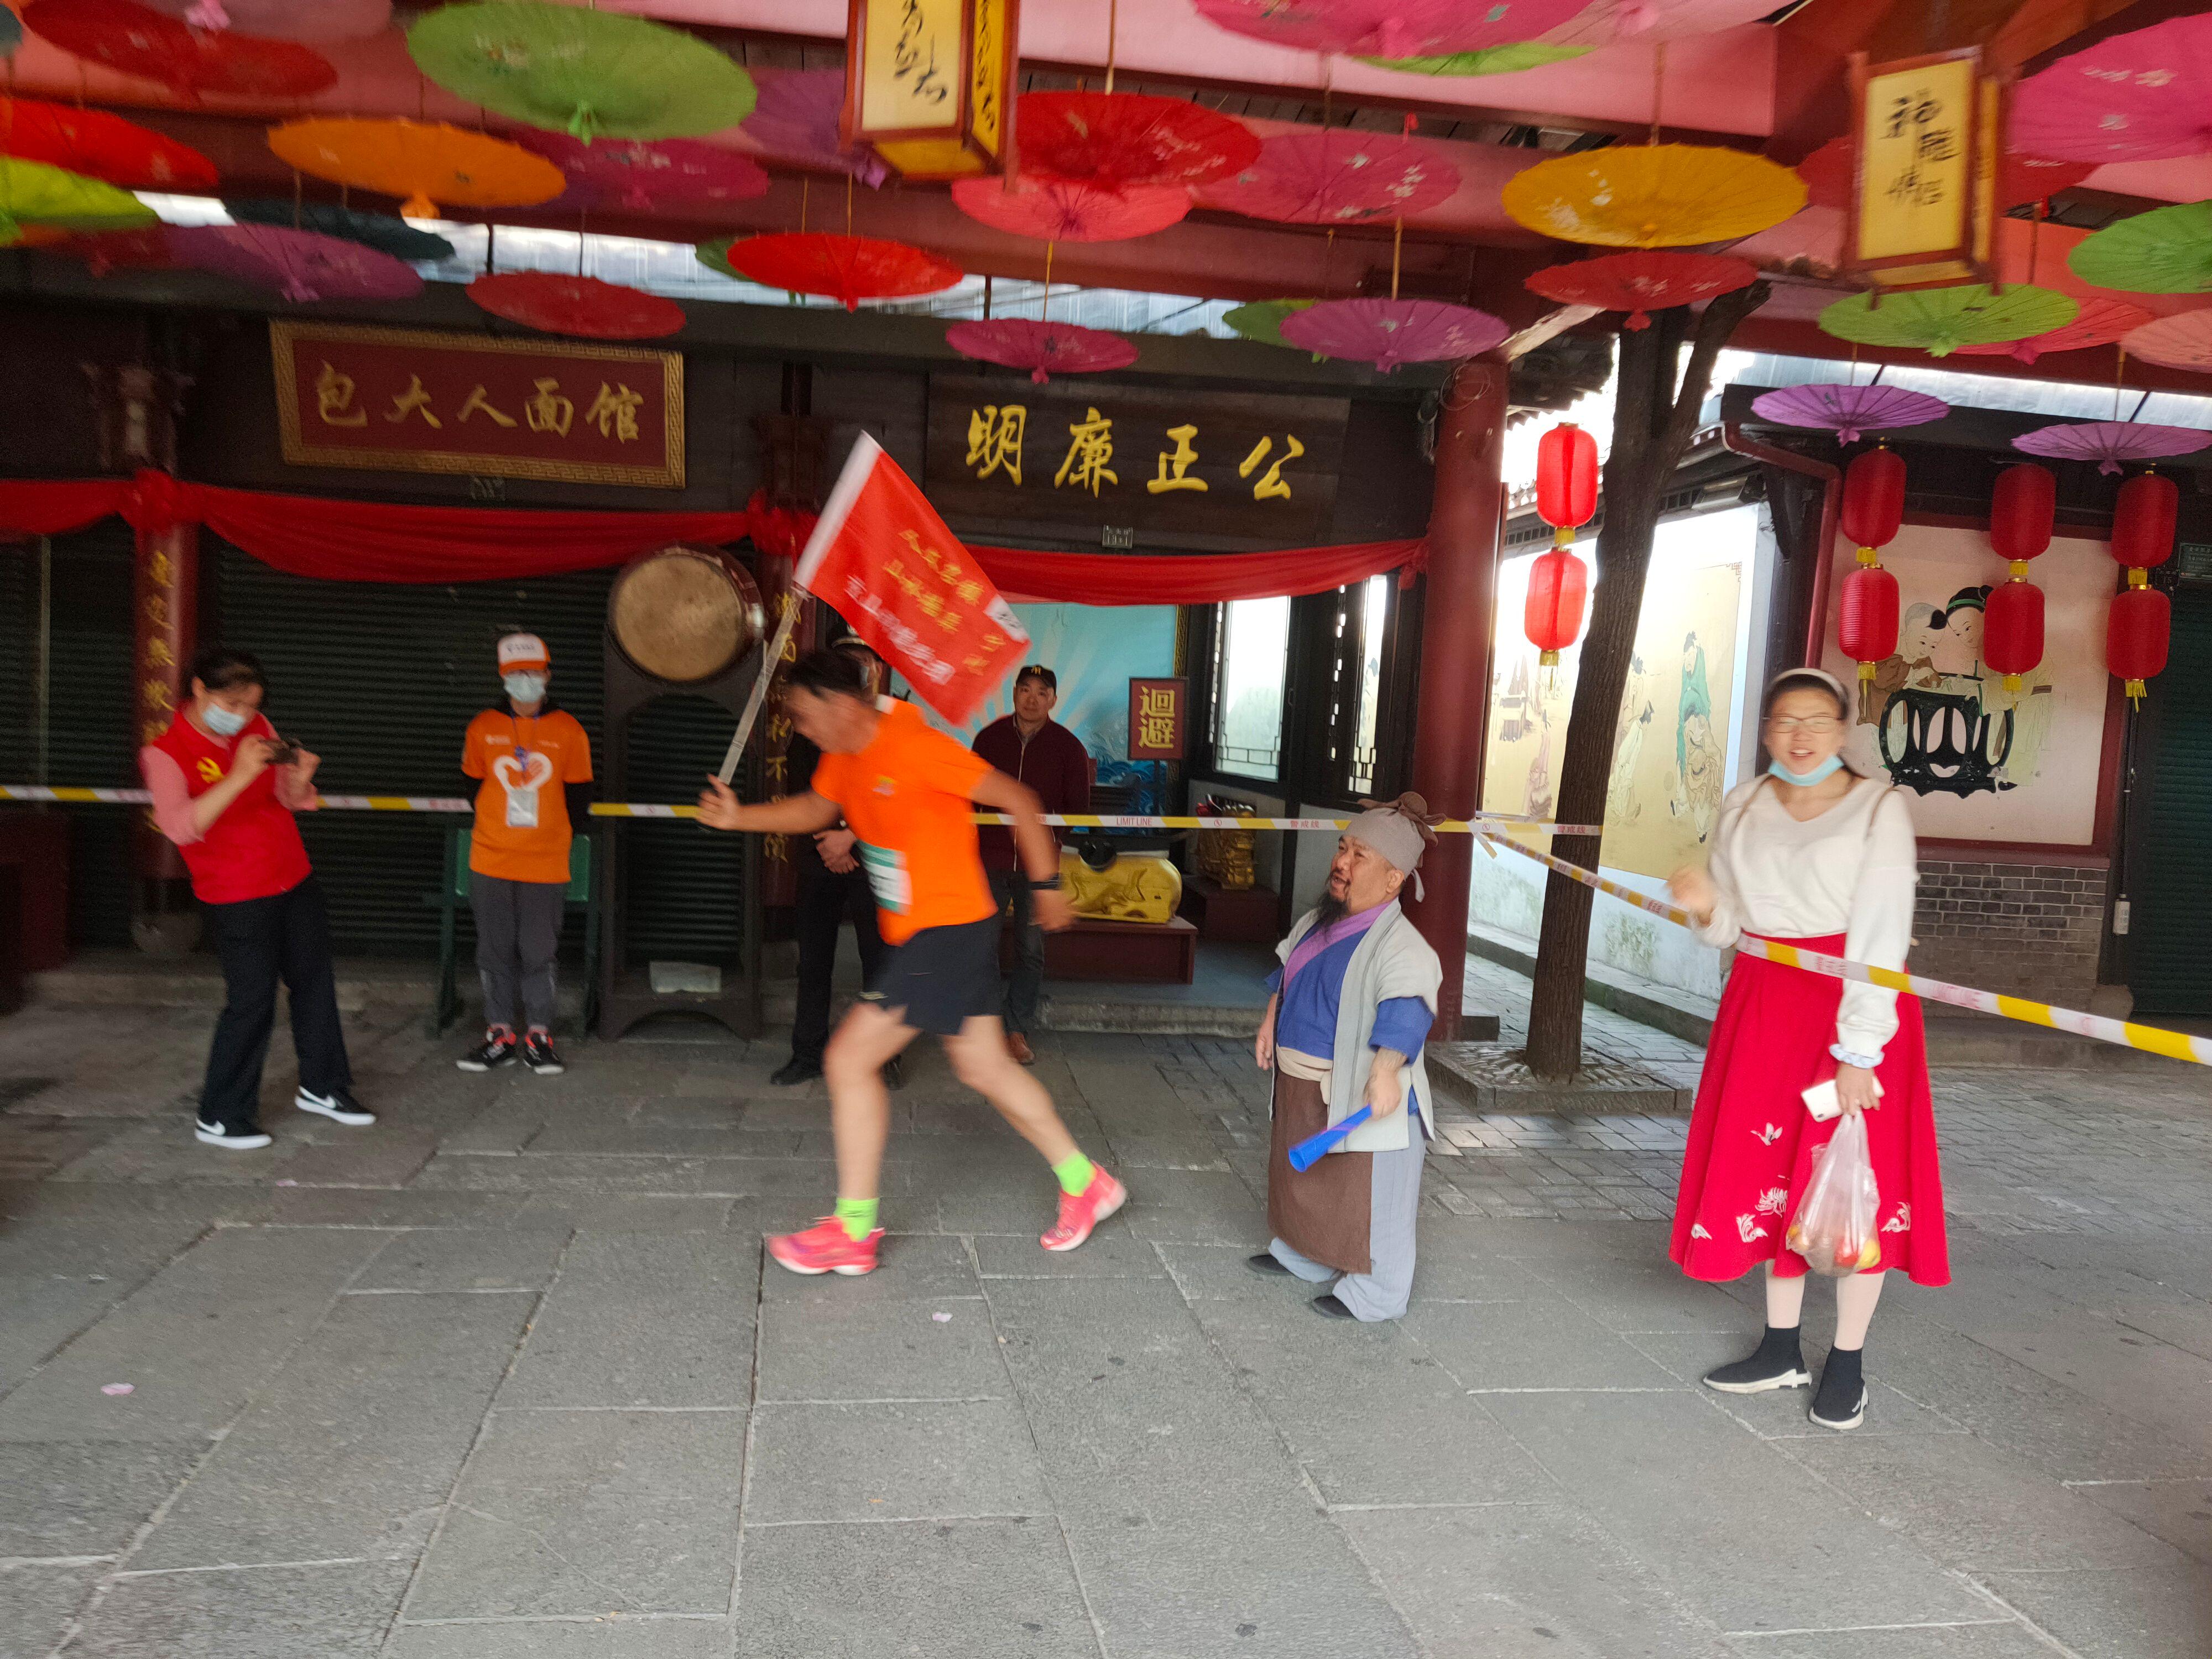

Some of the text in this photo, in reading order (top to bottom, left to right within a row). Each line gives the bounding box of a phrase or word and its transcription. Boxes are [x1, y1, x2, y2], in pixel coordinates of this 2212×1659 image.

[314, 359, 645, 444] 包大人面馆
[1138, 686, 1176, 749] 迴避
[1116, 816, 1152, 826] LIMIT LINE
